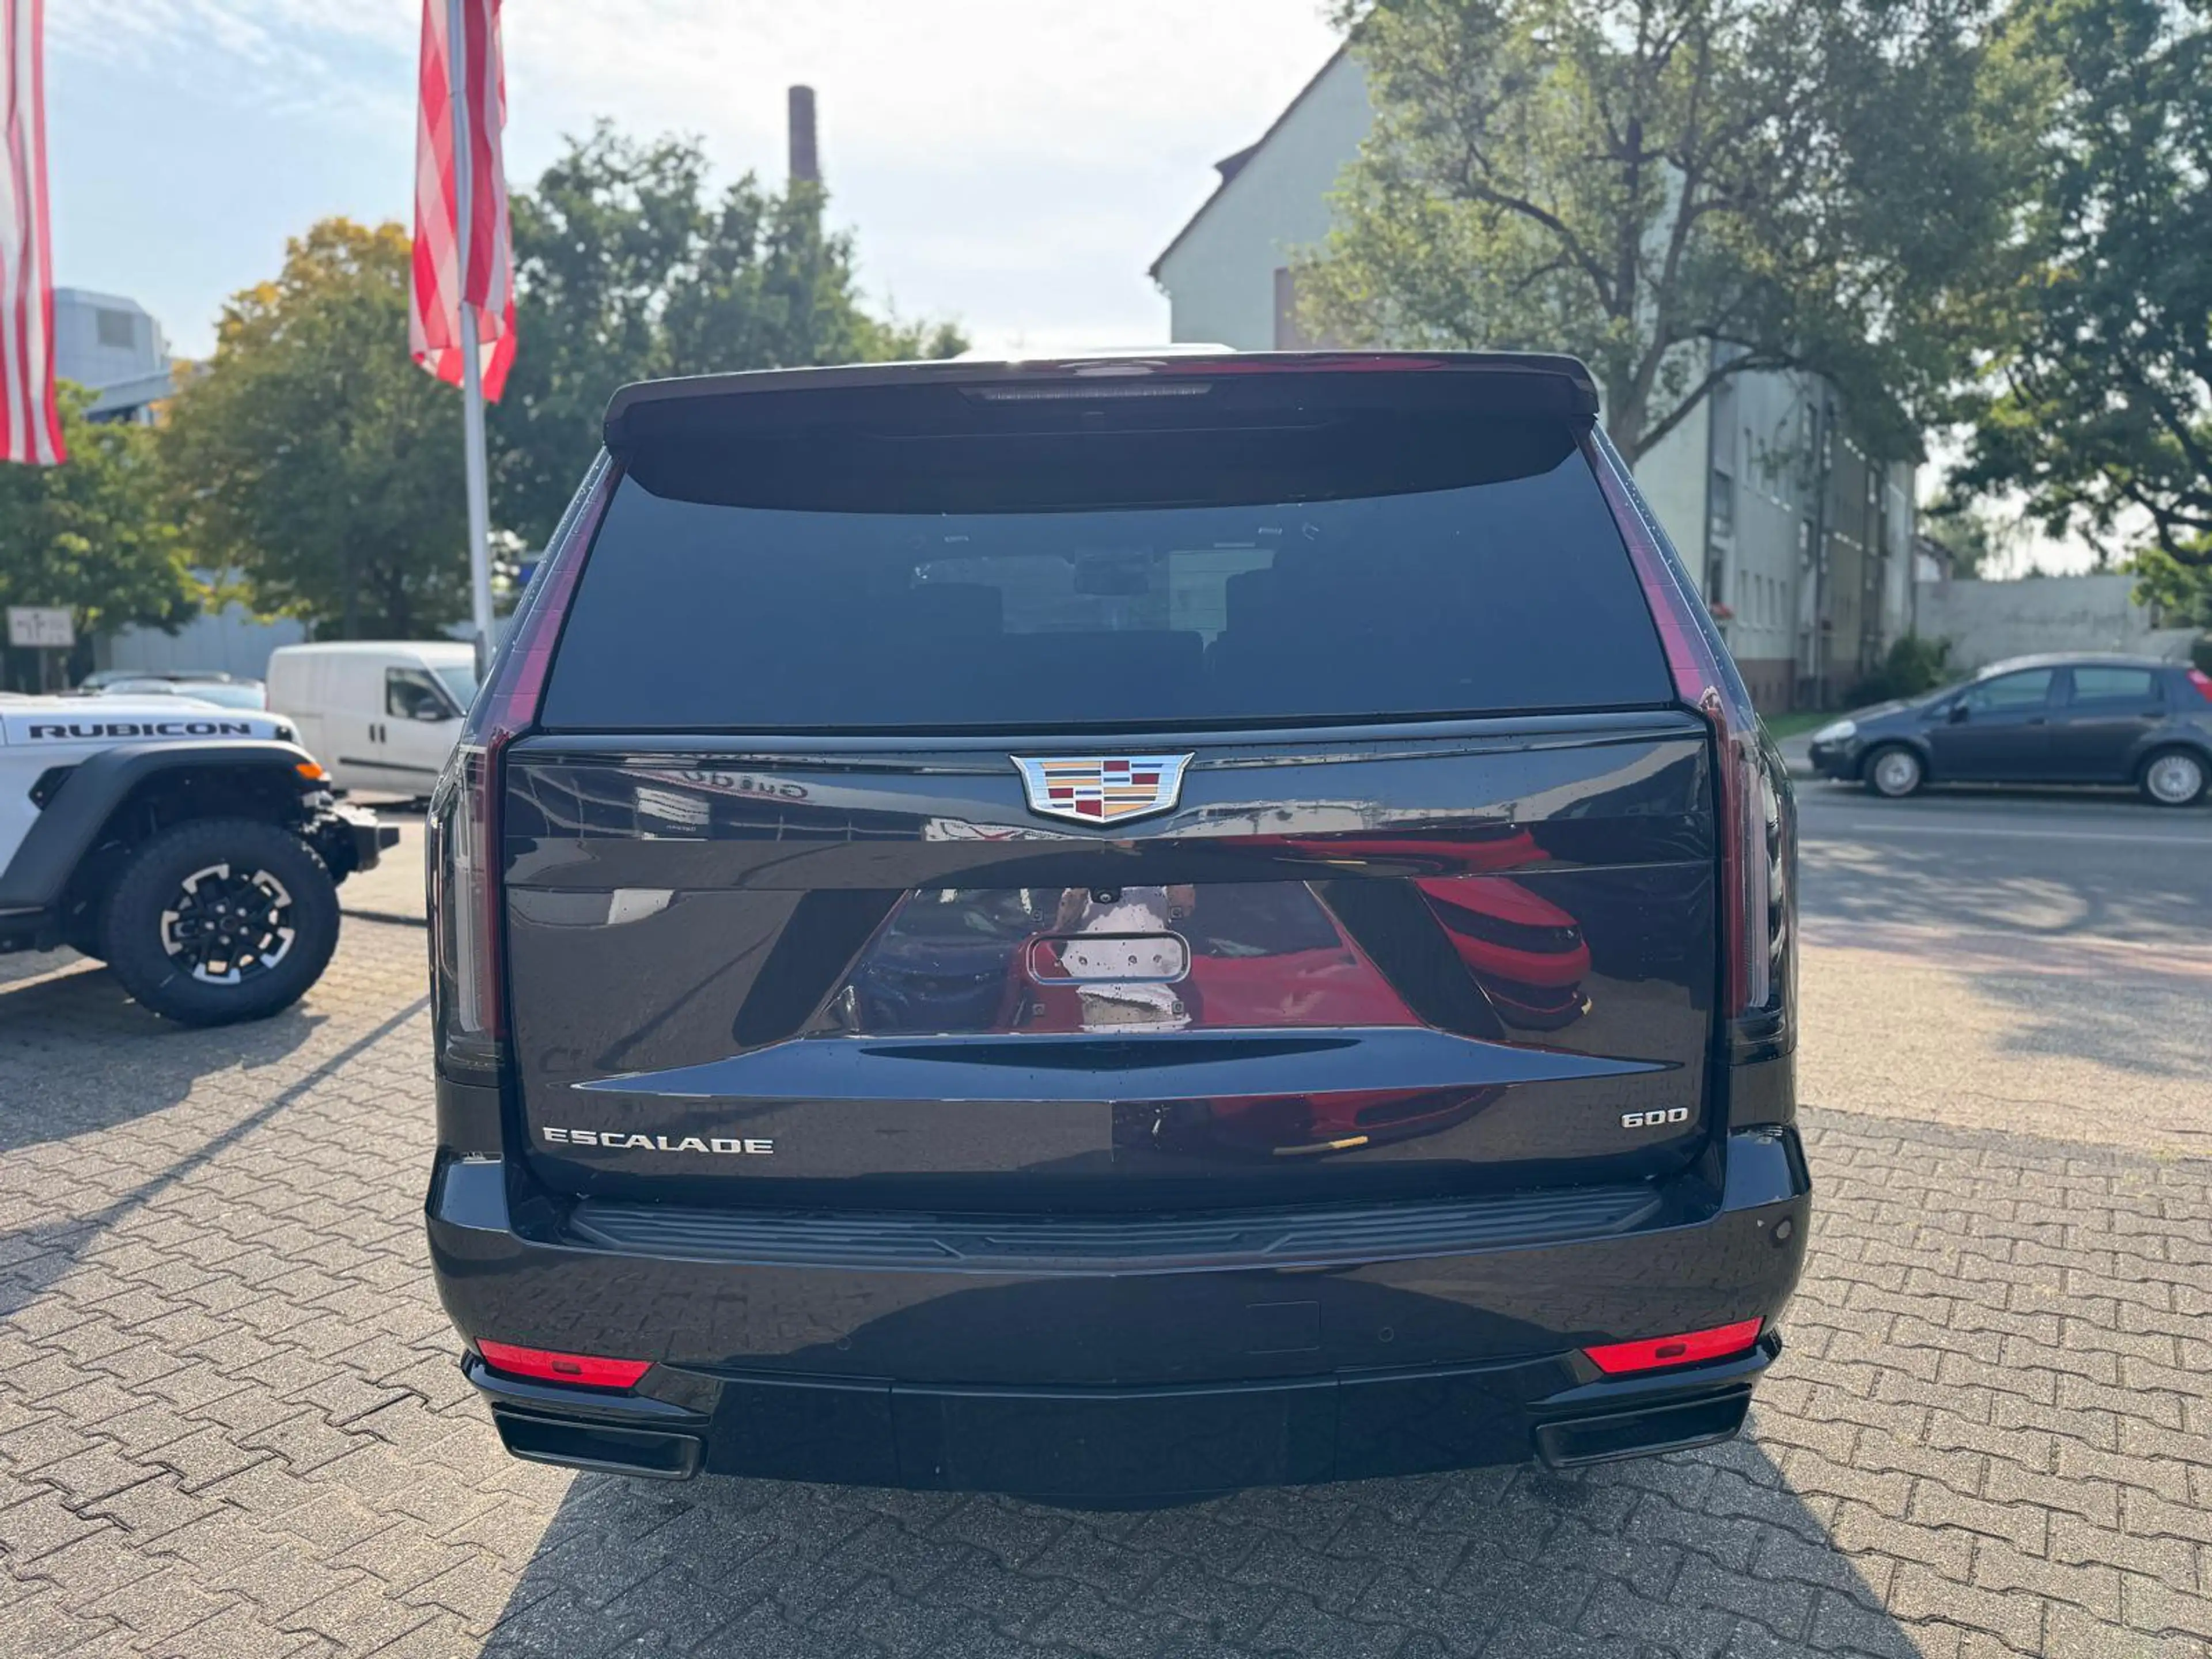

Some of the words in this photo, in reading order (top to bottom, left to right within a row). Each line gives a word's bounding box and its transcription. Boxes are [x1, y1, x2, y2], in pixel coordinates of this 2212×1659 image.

[29, 722, 251, 738] RUBICON
[1621, 1107, 1688, 1128] 600
[543, 1127, 774, 1154] ESCALADE
